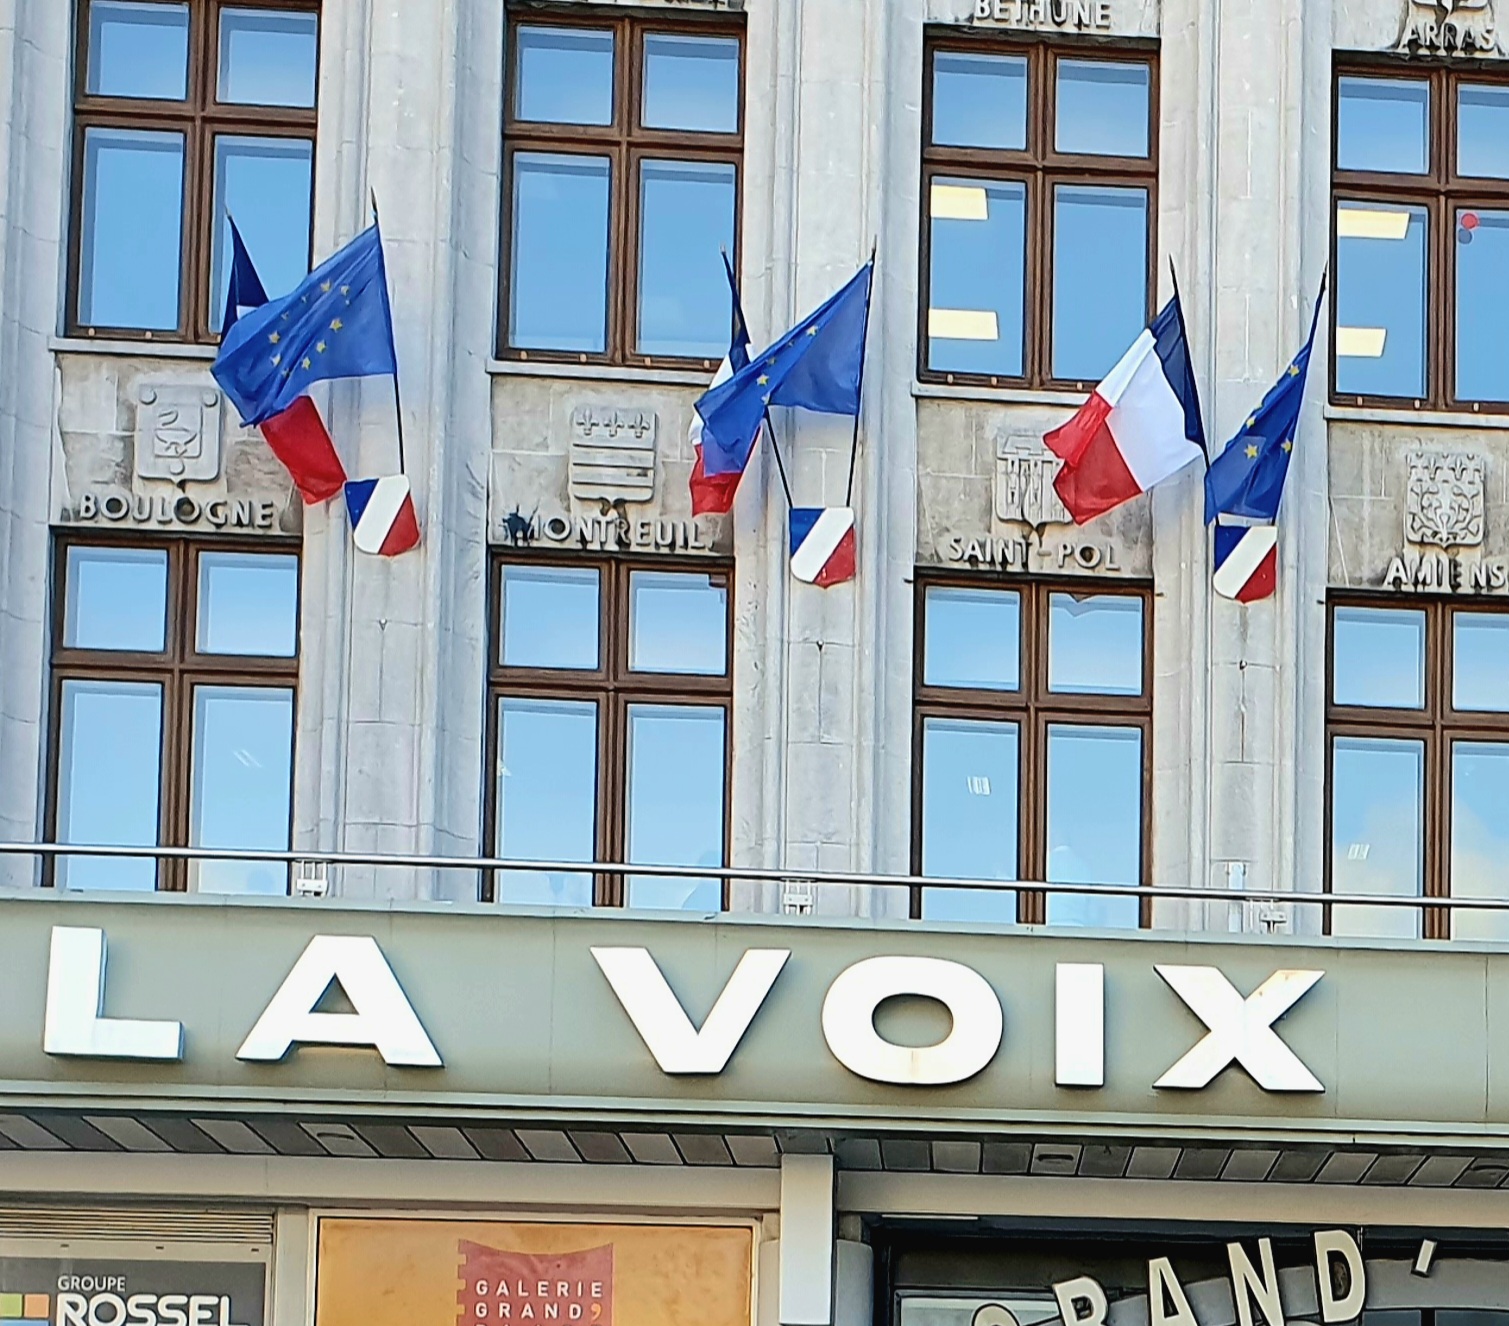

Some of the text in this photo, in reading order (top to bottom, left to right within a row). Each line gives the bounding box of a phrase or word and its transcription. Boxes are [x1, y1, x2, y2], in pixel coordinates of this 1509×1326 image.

[1402, 23, 1496, 51] ARRAS
[80, 494, 274, 528] BOULOGNE
[1386, 557, 1506, 588] AMIENS
[44, 925, 445, 1069] LA
[589, 945, 1326, 1093] VOIX
[56, 1275, 127, 1292] GROUPE
[475, 1279, 603, 1298] GALERIE
